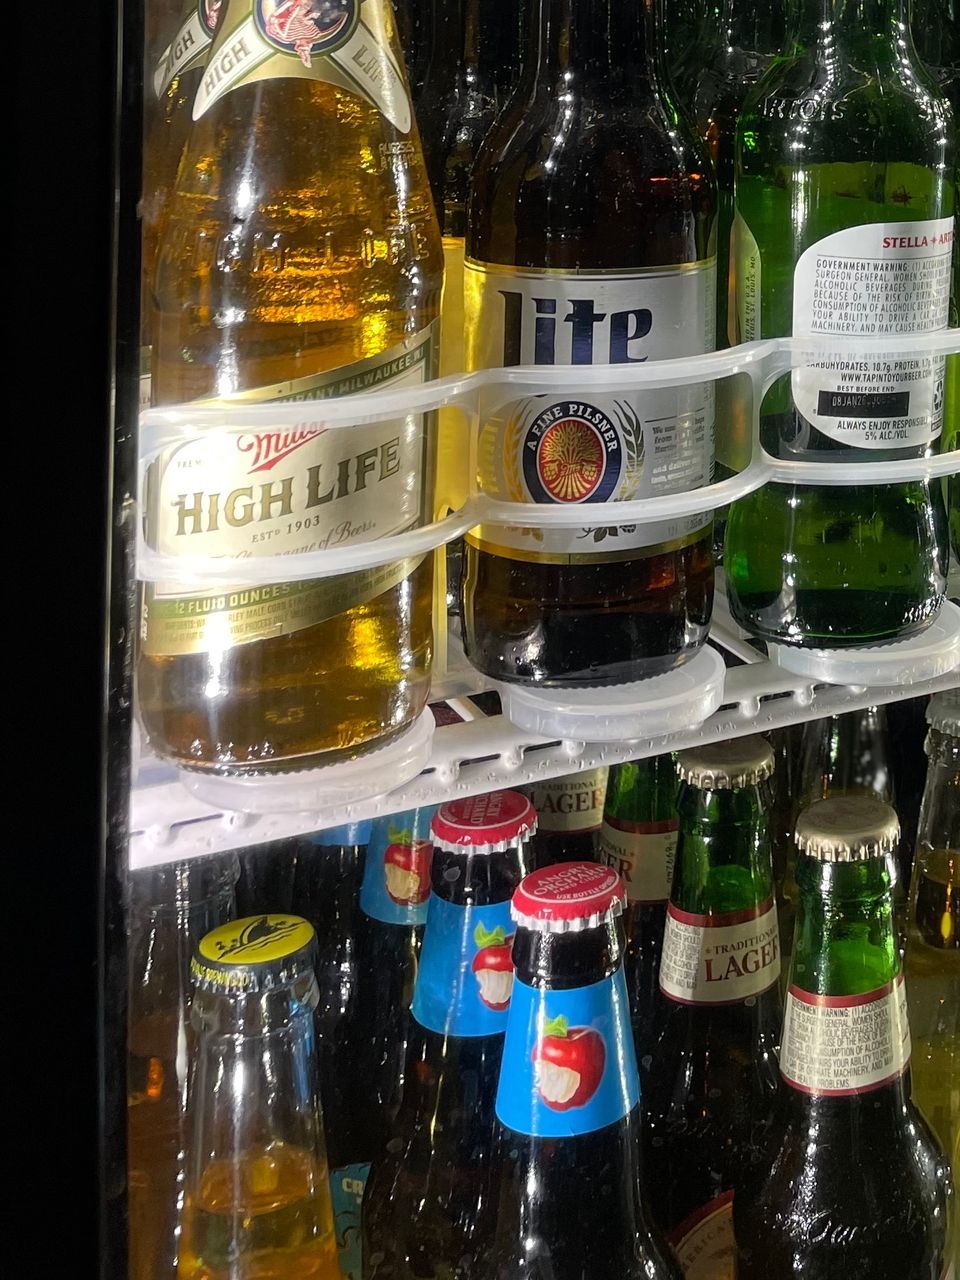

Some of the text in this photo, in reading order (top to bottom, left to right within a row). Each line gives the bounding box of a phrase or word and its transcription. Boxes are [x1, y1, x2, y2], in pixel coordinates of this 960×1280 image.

[202, 38, 251, 99] HIGH
[882, 236, 928, 248] STELLA
[816, 259, 908, 272] GOVERNMENT WARNING:
[815, 269, 851, 280] SURGEON
[893, 272, 917, 281] WOMEN
[814, 280, 857, 291] ALCOHOLIC
[865, 282, 906, 292] BEVERAGES
[814, 289, 912, 302] BECAUSE OF THE RISK OF
[812, 299, 916, 312] CONSUMPTION OF ALCOHOLIC
[812, 309, 833, 319] YOUR
[838, 311, 869, 322] ABILITY
[874, 314, 883, 322] TO
[888, 313, 908, 322] DRIVE
[498, 290, 653, 368] lite
[811, 321, 914, 333] MACHINERY, AND MAY CAUSE
[856, 385, 880, 393] BEFORE
[527, 403, 618, 453] A FINE PILSNER
[837, 420, 890, 431] ALWAYS ENJOY
[865, 432, 877, 441] 5%
[170, 437, 401, 537] HIGH LIFE
[286, 515, 321, 536] 1903
[188, 597, 226, 613] FLUID
[229, 584, 290, 607] OUNCES
[533, 865, 608, 895] ORCHARD
[538, 863, 590, 888] ANGRY
[556, 886, 601, 900] USE BOTTLE
